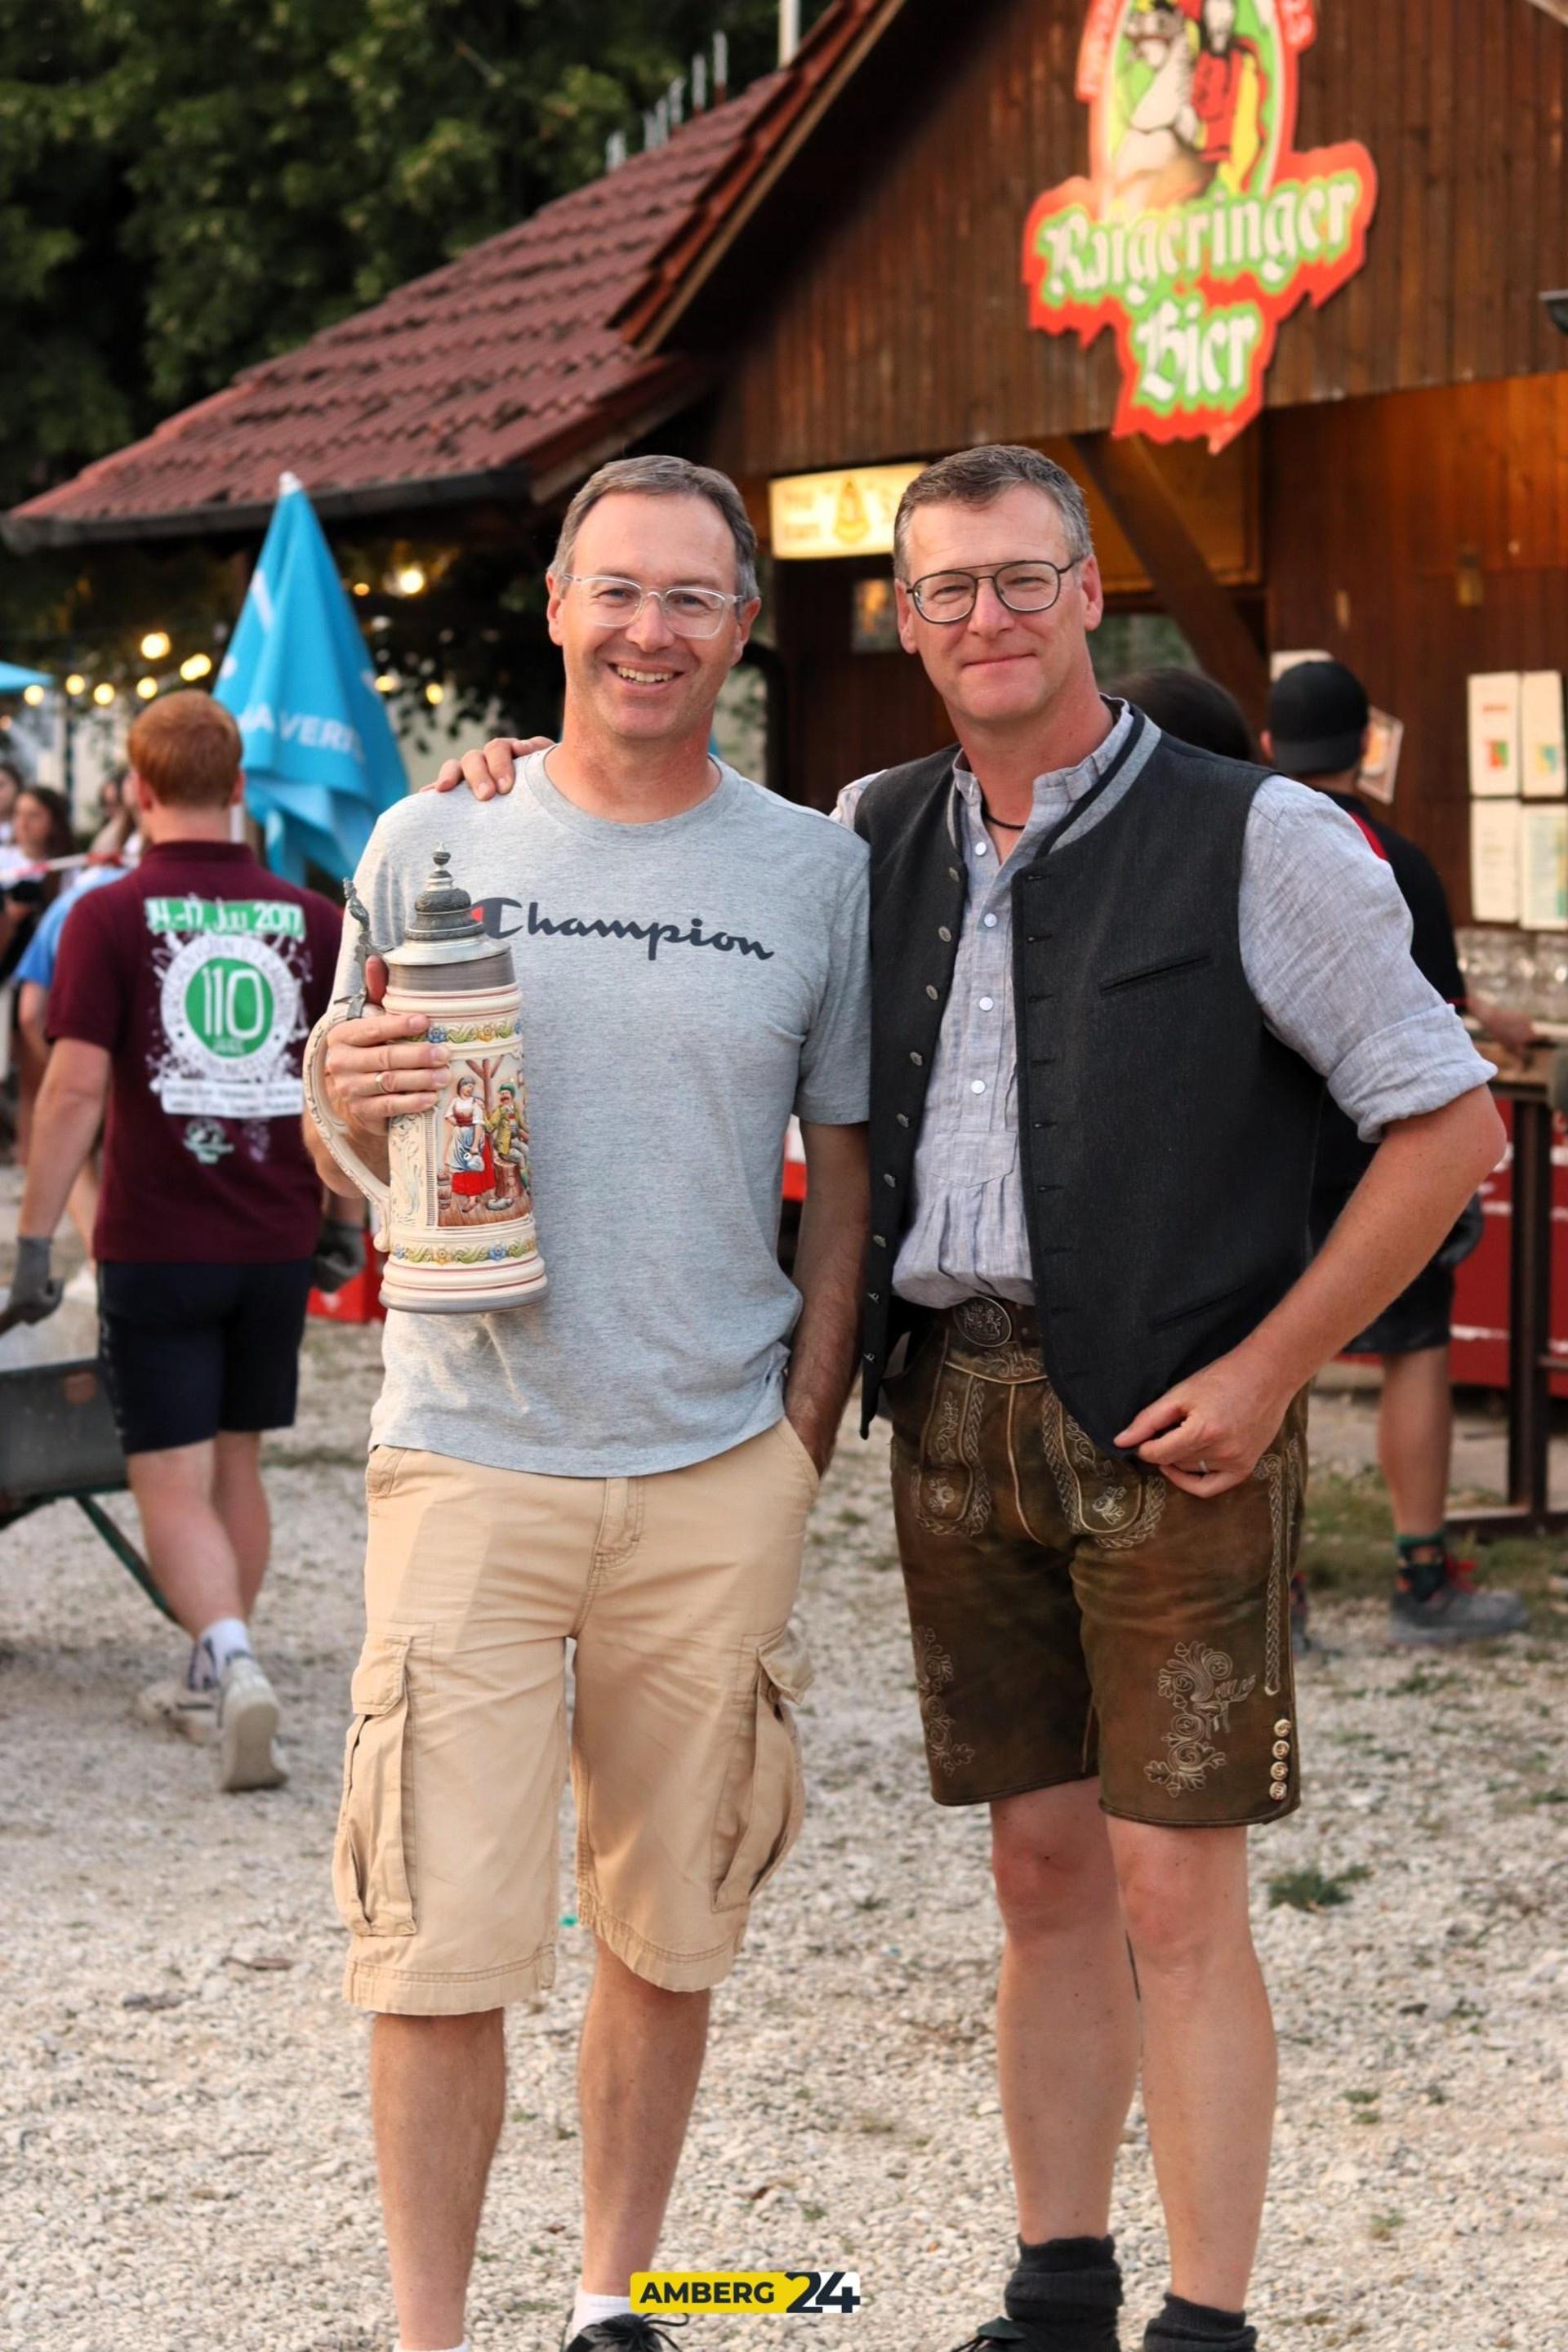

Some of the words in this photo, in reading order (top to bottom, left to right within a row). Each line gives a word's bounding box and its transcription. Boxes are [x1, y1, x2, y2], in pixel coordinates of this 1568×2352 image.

[1136, 299, 1258, 401] Bier
[471, 897, 775, 961] Champion
[201, 966, 265, 1040] 110
